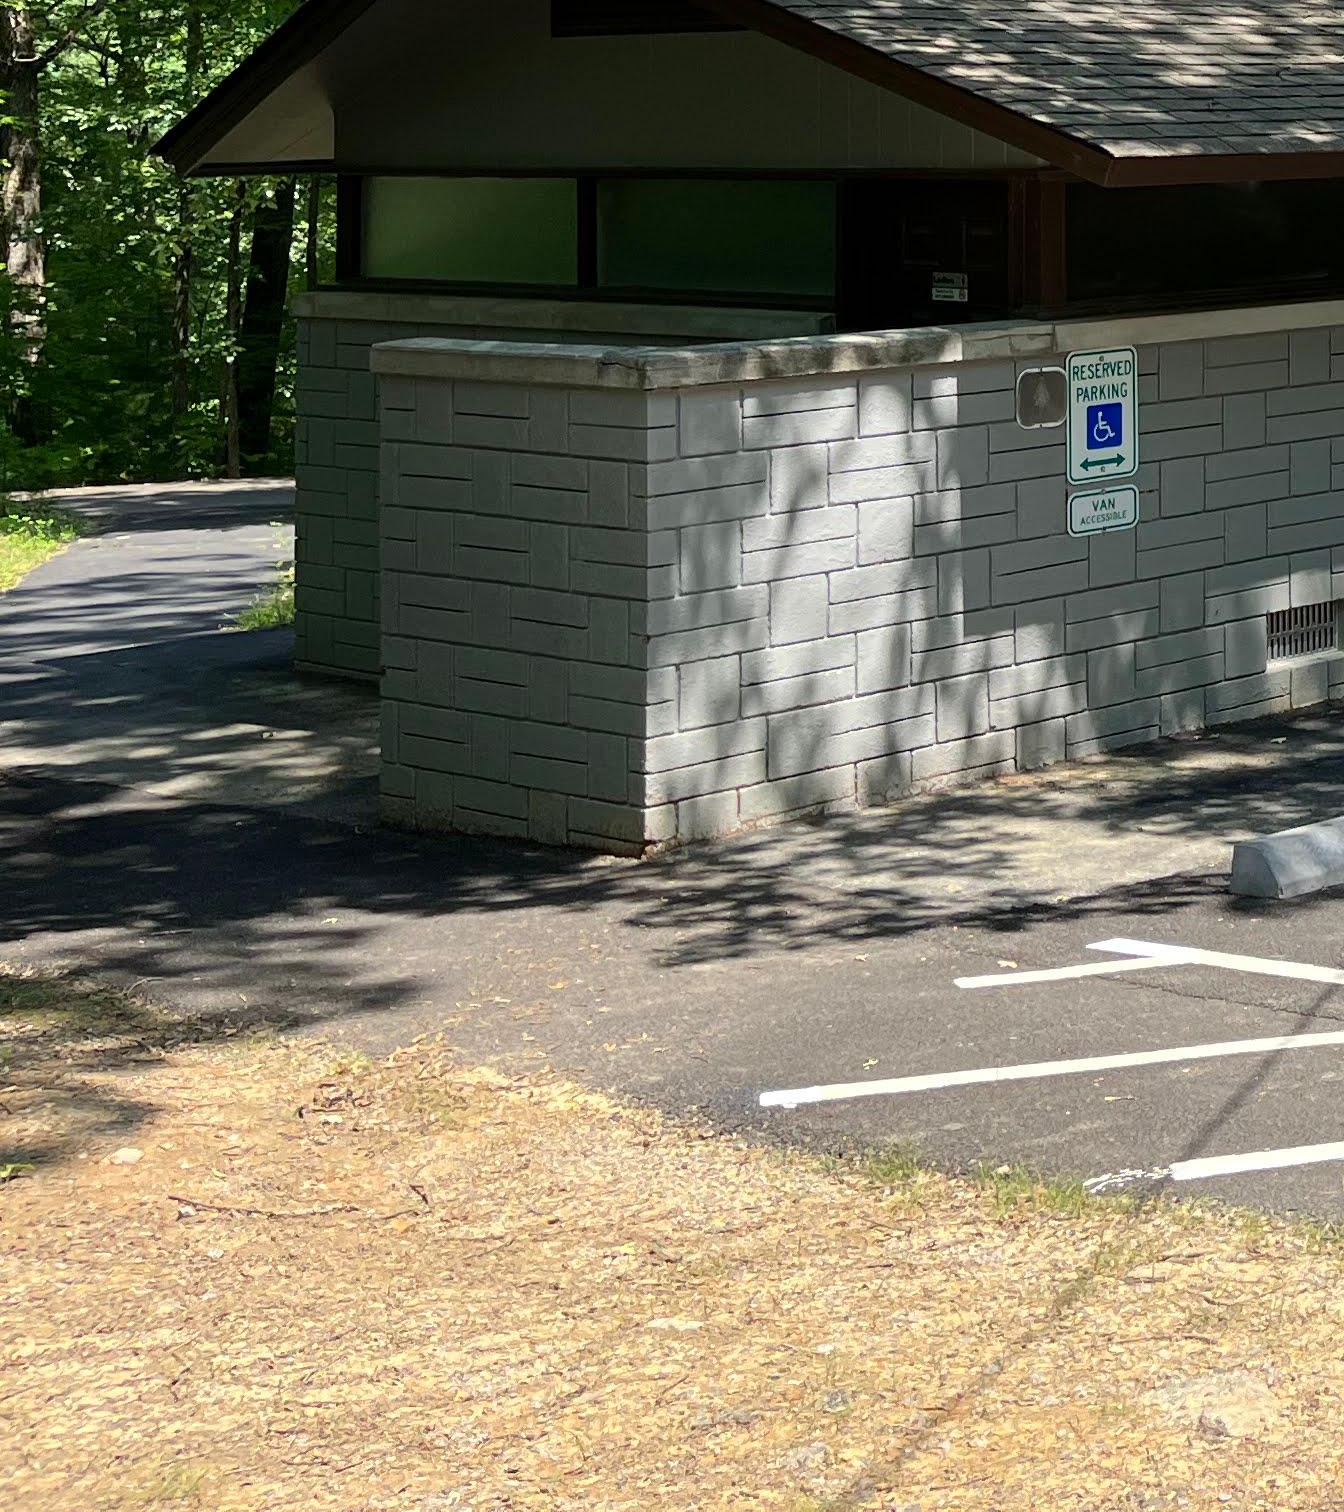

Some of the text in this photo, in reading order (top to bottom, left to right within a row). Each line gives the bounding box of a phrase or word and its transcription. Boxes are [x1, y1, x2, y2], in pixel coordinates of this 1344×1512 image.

[1072, 360, 1132, 381] RESERVED
[1076, 383, 1128, 403] PARKING
[1092, 497, 1116, 512] VAN
[1080, 510, 1127, 526] ACCESSIBLE
